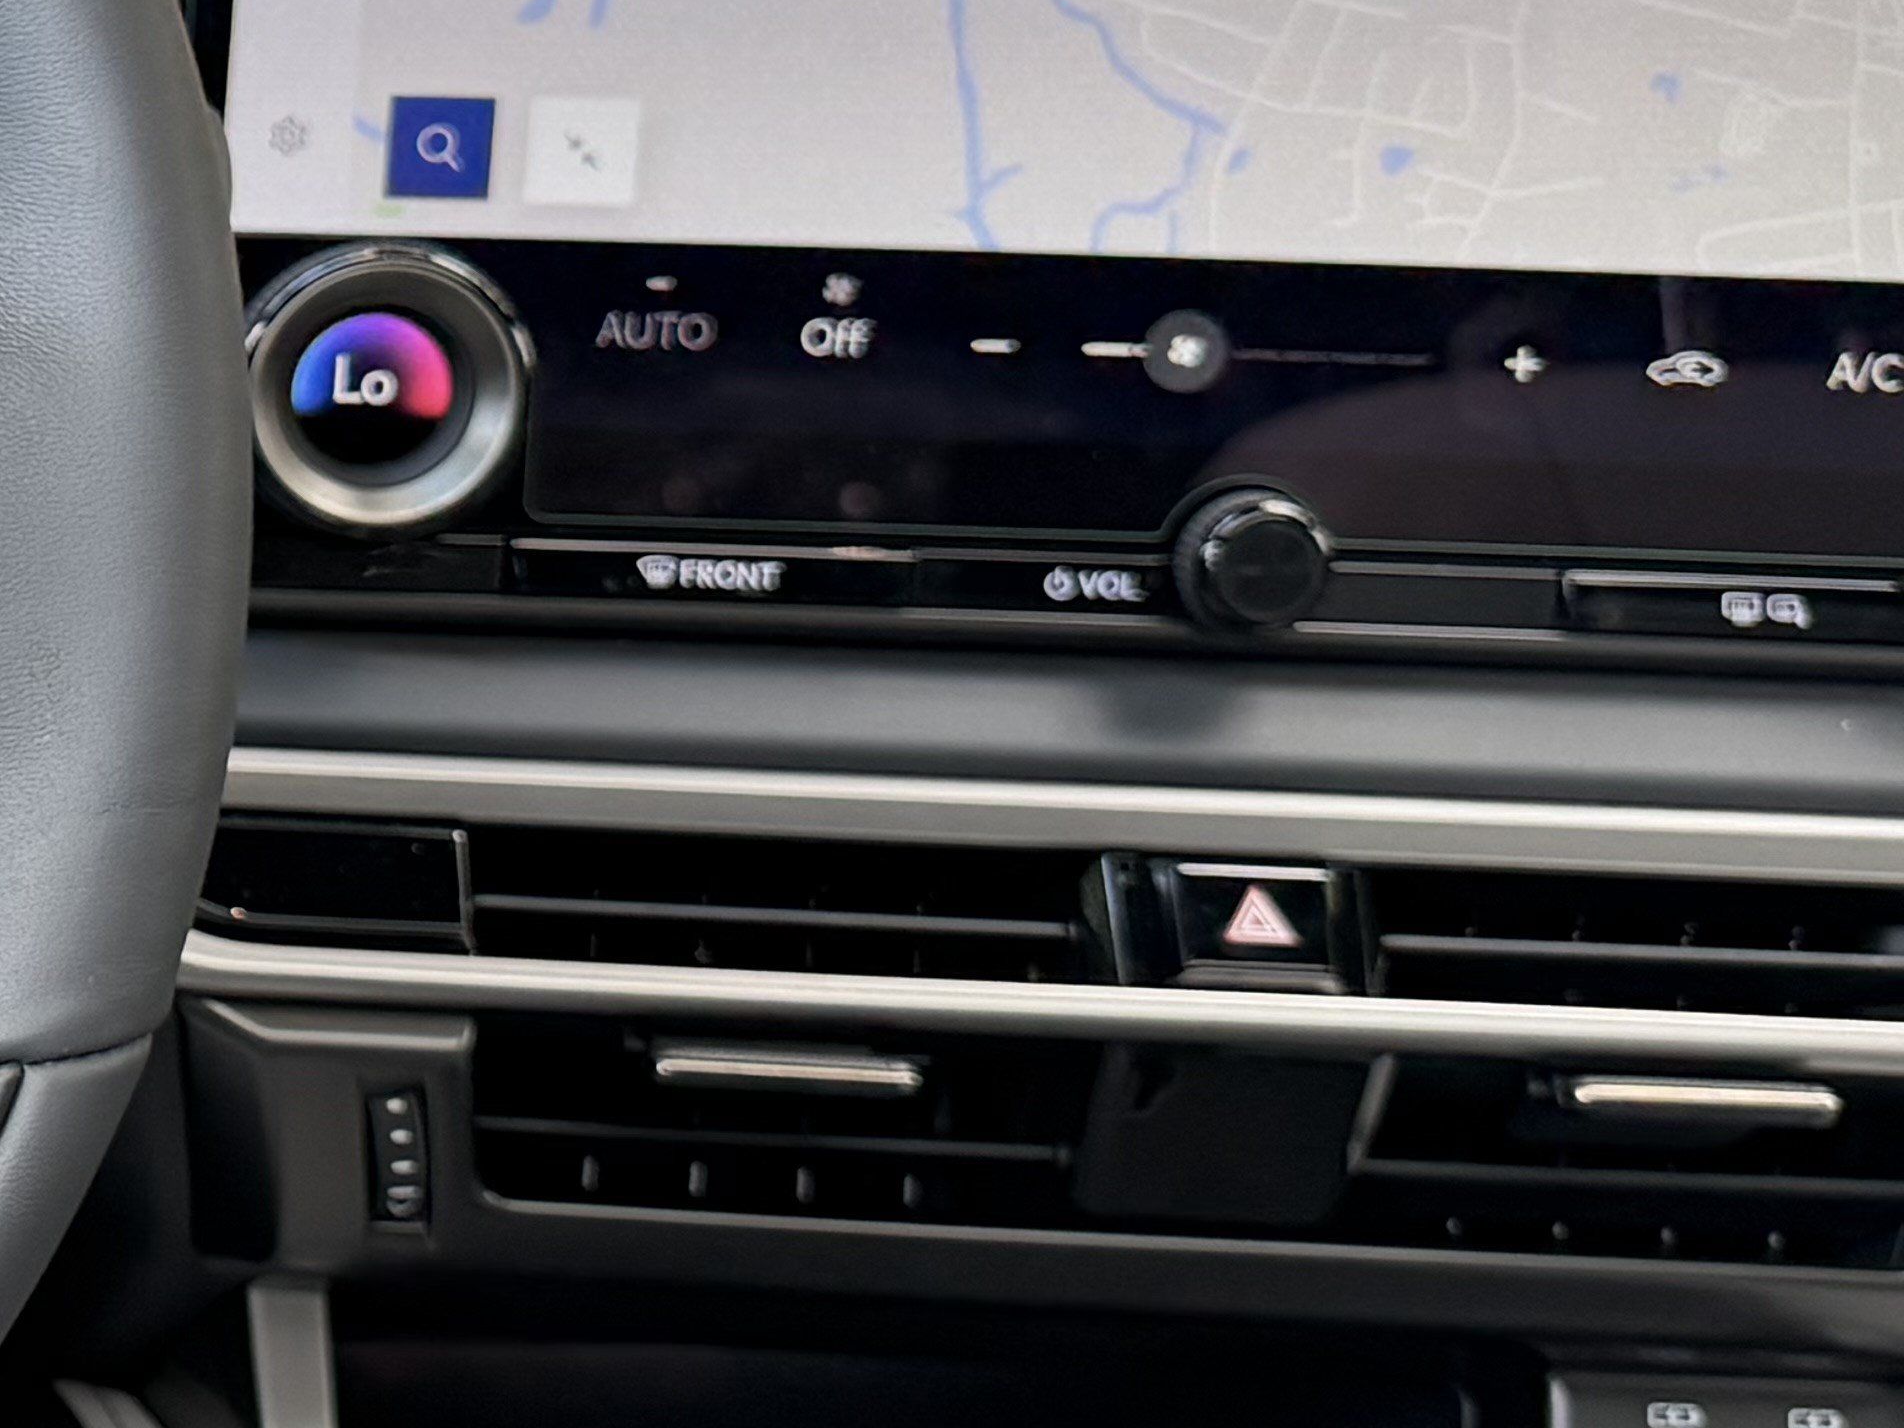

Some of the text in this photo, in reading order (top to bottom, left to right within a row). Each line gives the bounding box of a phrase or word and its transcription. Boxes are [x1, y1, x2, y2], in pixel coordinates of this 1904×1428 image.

[595, 310, 718, 353] AUTO
[800, 315, 877, 358] Off
[333, 352, 399, 408] Lo
[679, 559, 787, 592] FRONT
[1078, 569, 1149, 602] VOL
